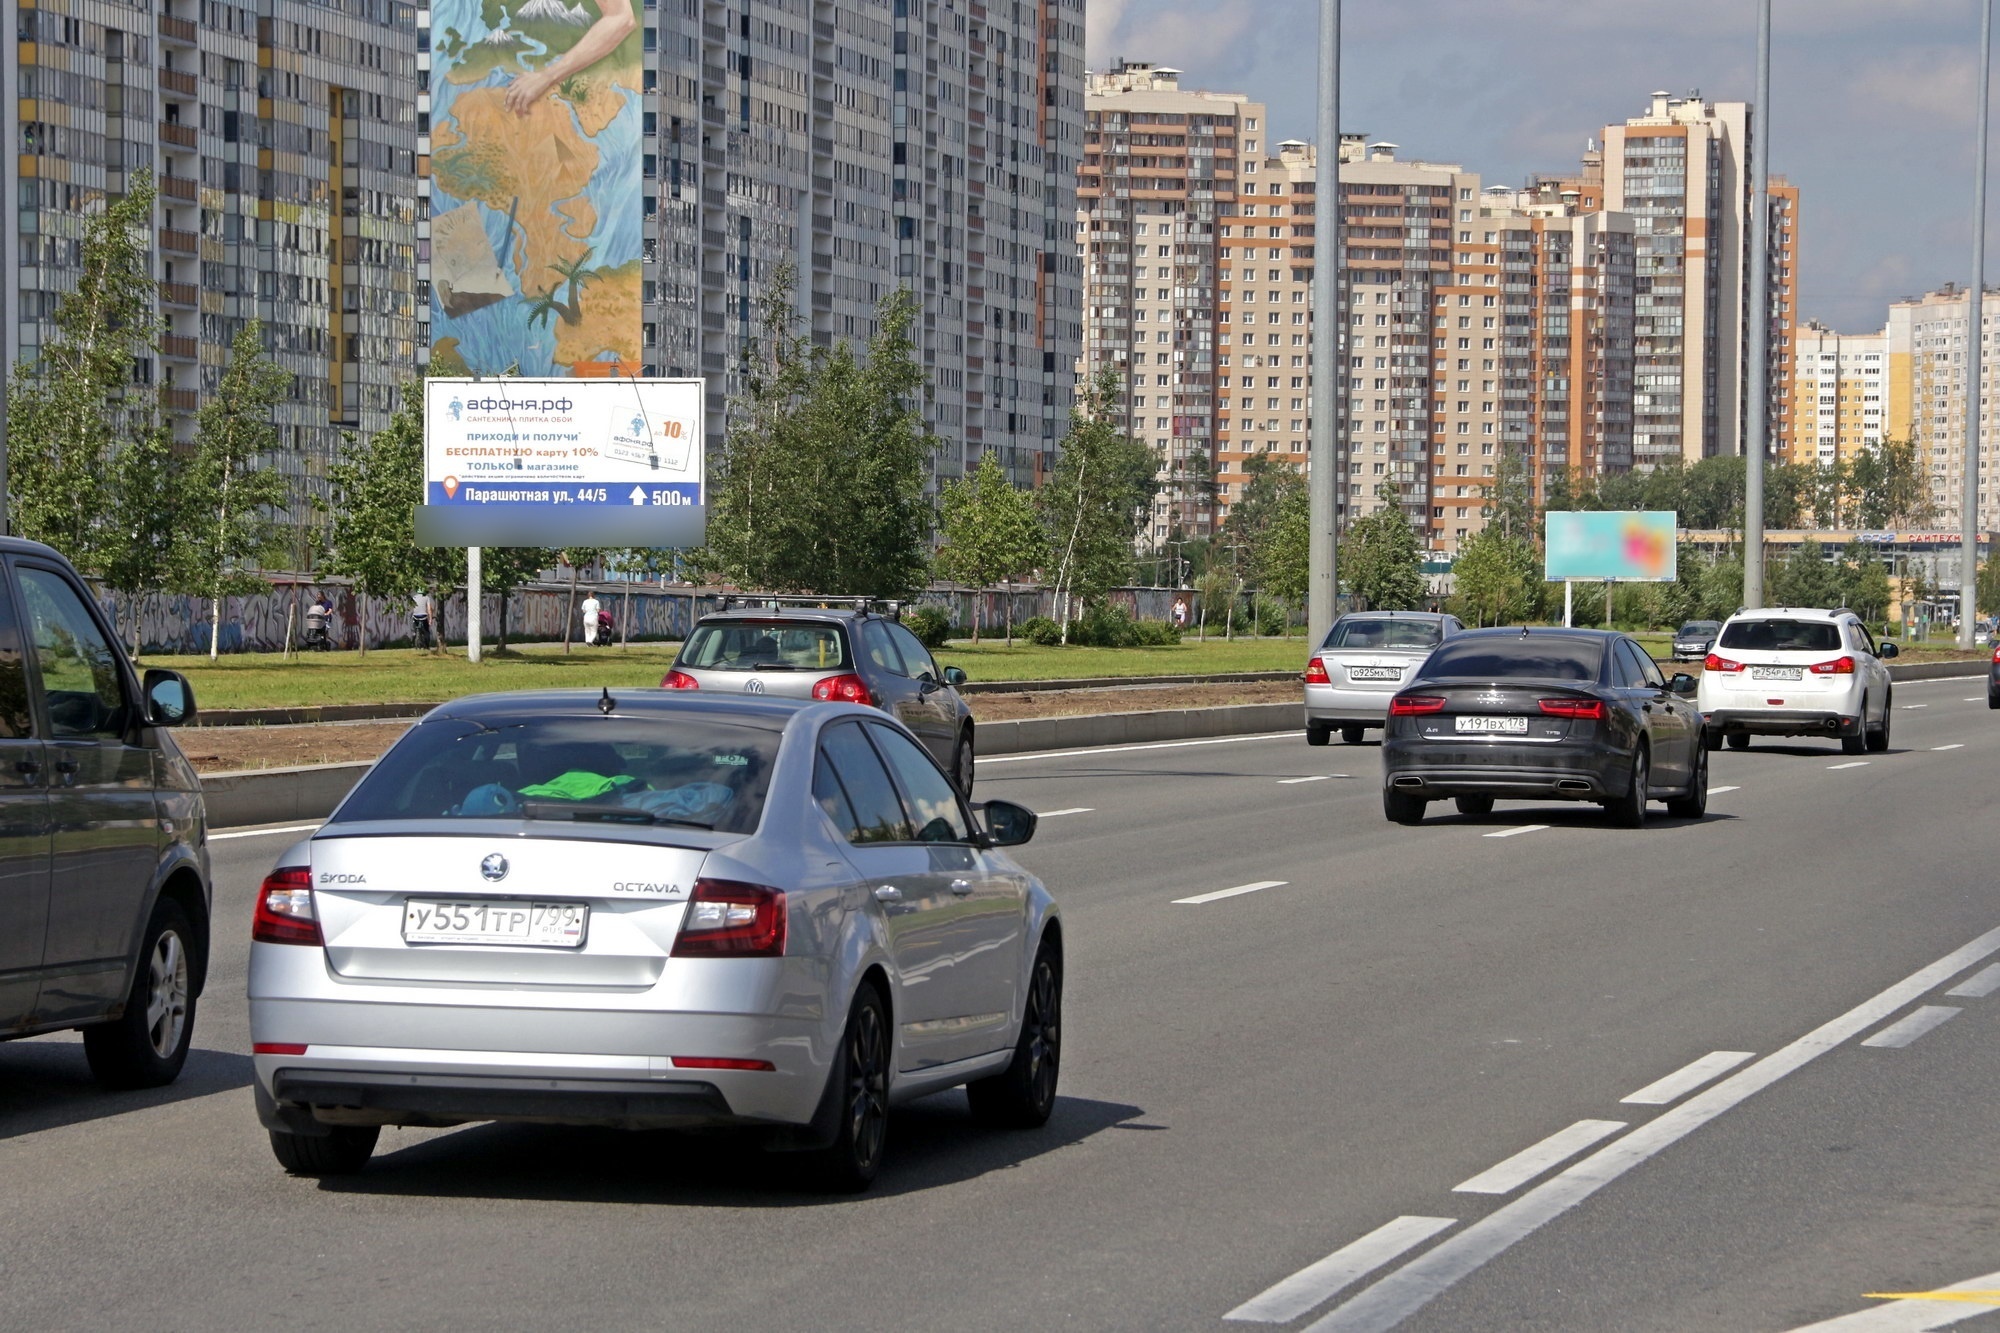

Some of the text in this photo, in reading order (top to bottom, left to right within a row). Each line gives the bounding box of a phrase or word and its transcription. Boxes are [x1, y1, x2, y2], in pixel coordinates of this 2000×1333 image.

[466, 396, 573, 414] афоня.рф
[466, 433, 519, 442] ПРИХОДИ
[522, 433, 530, 441] И
[613, 436, 654, 447] афоня.рф
[446, 447, 599, 458] БЕСПЛАТНУЮ карту 10%
[466, 462, 514, 471] ТОЛЬКО
[465, 487, 549, 503] Парашютная
[577, 488, 607, 502] 44/5
[1507, 717, 1525, 727] 178
[613, 882, 681, 894] OCTAVIA
[533, 904, 576, 927] 799
[542, 926, 563, 935] RUS
